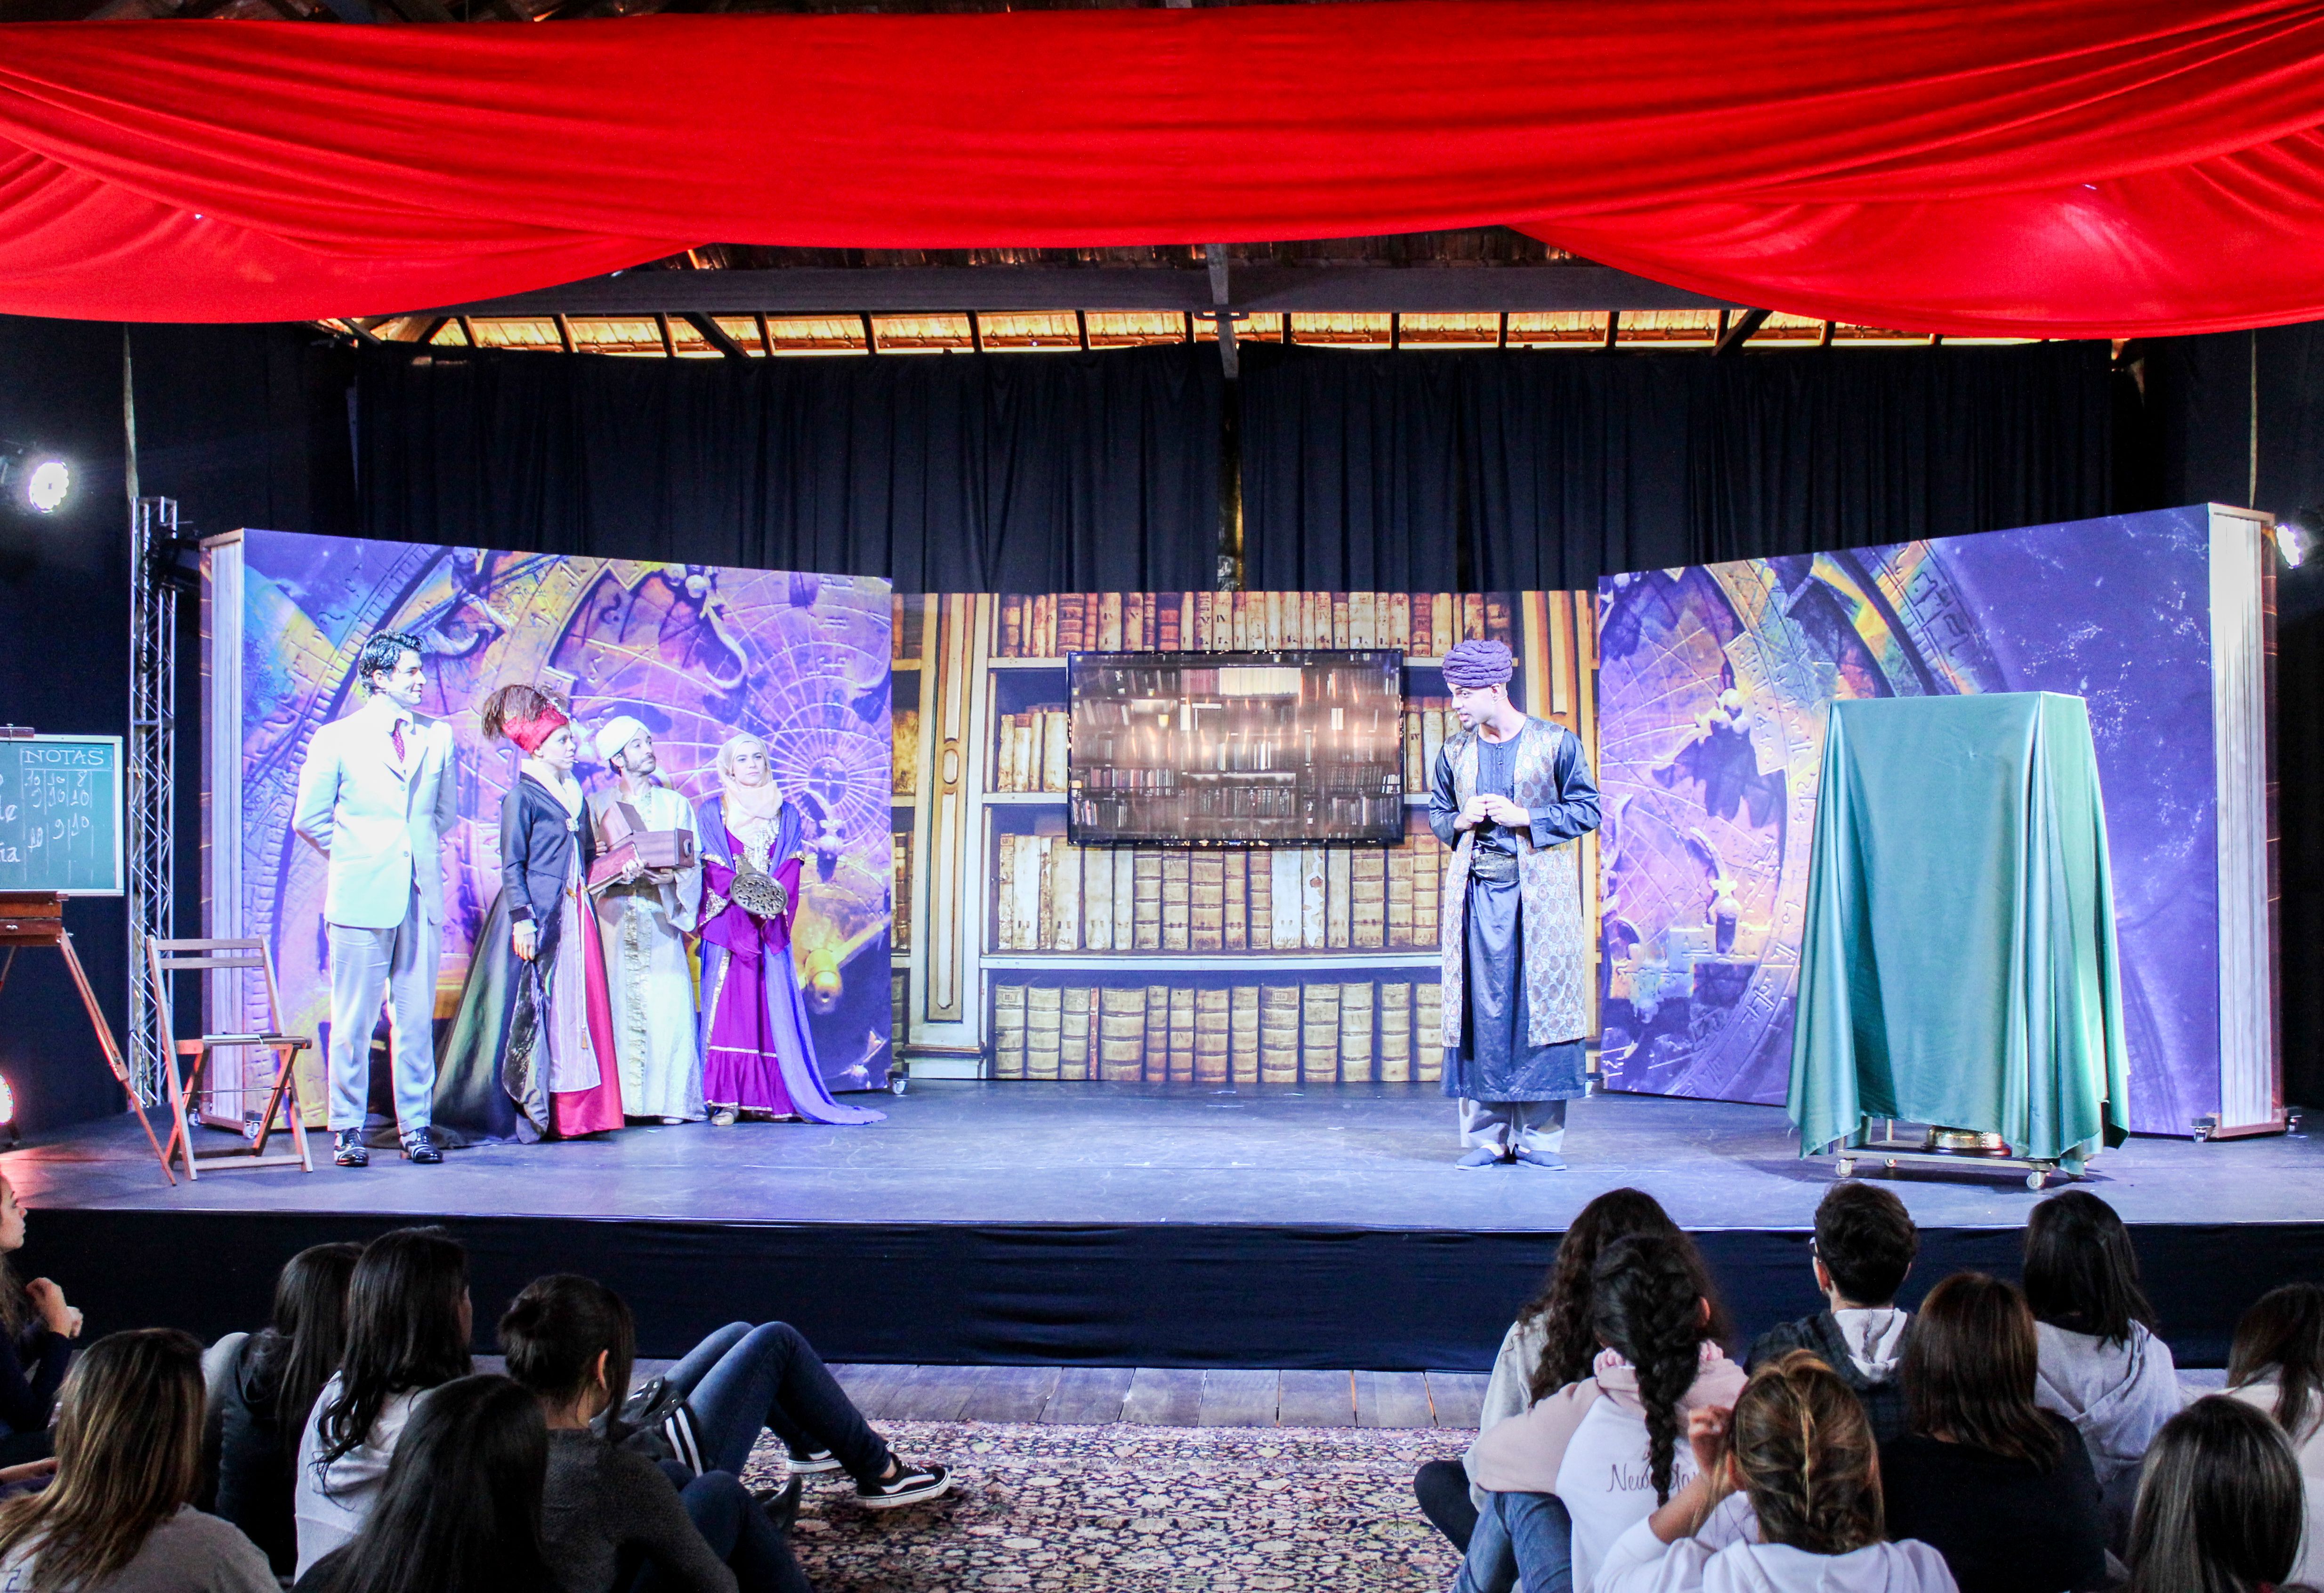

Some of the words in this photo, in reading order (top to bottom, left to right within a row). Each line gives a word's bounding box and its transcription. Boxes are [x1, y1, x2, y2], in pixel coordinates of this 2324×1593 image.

[24, 749, 104, 765] NOTAS
[70, 789, 89, 806] 10
[53, 819, 64, 839] 9
[71, 813, 89, 836] 10
[1606, 1464, 1650, 1492] New
